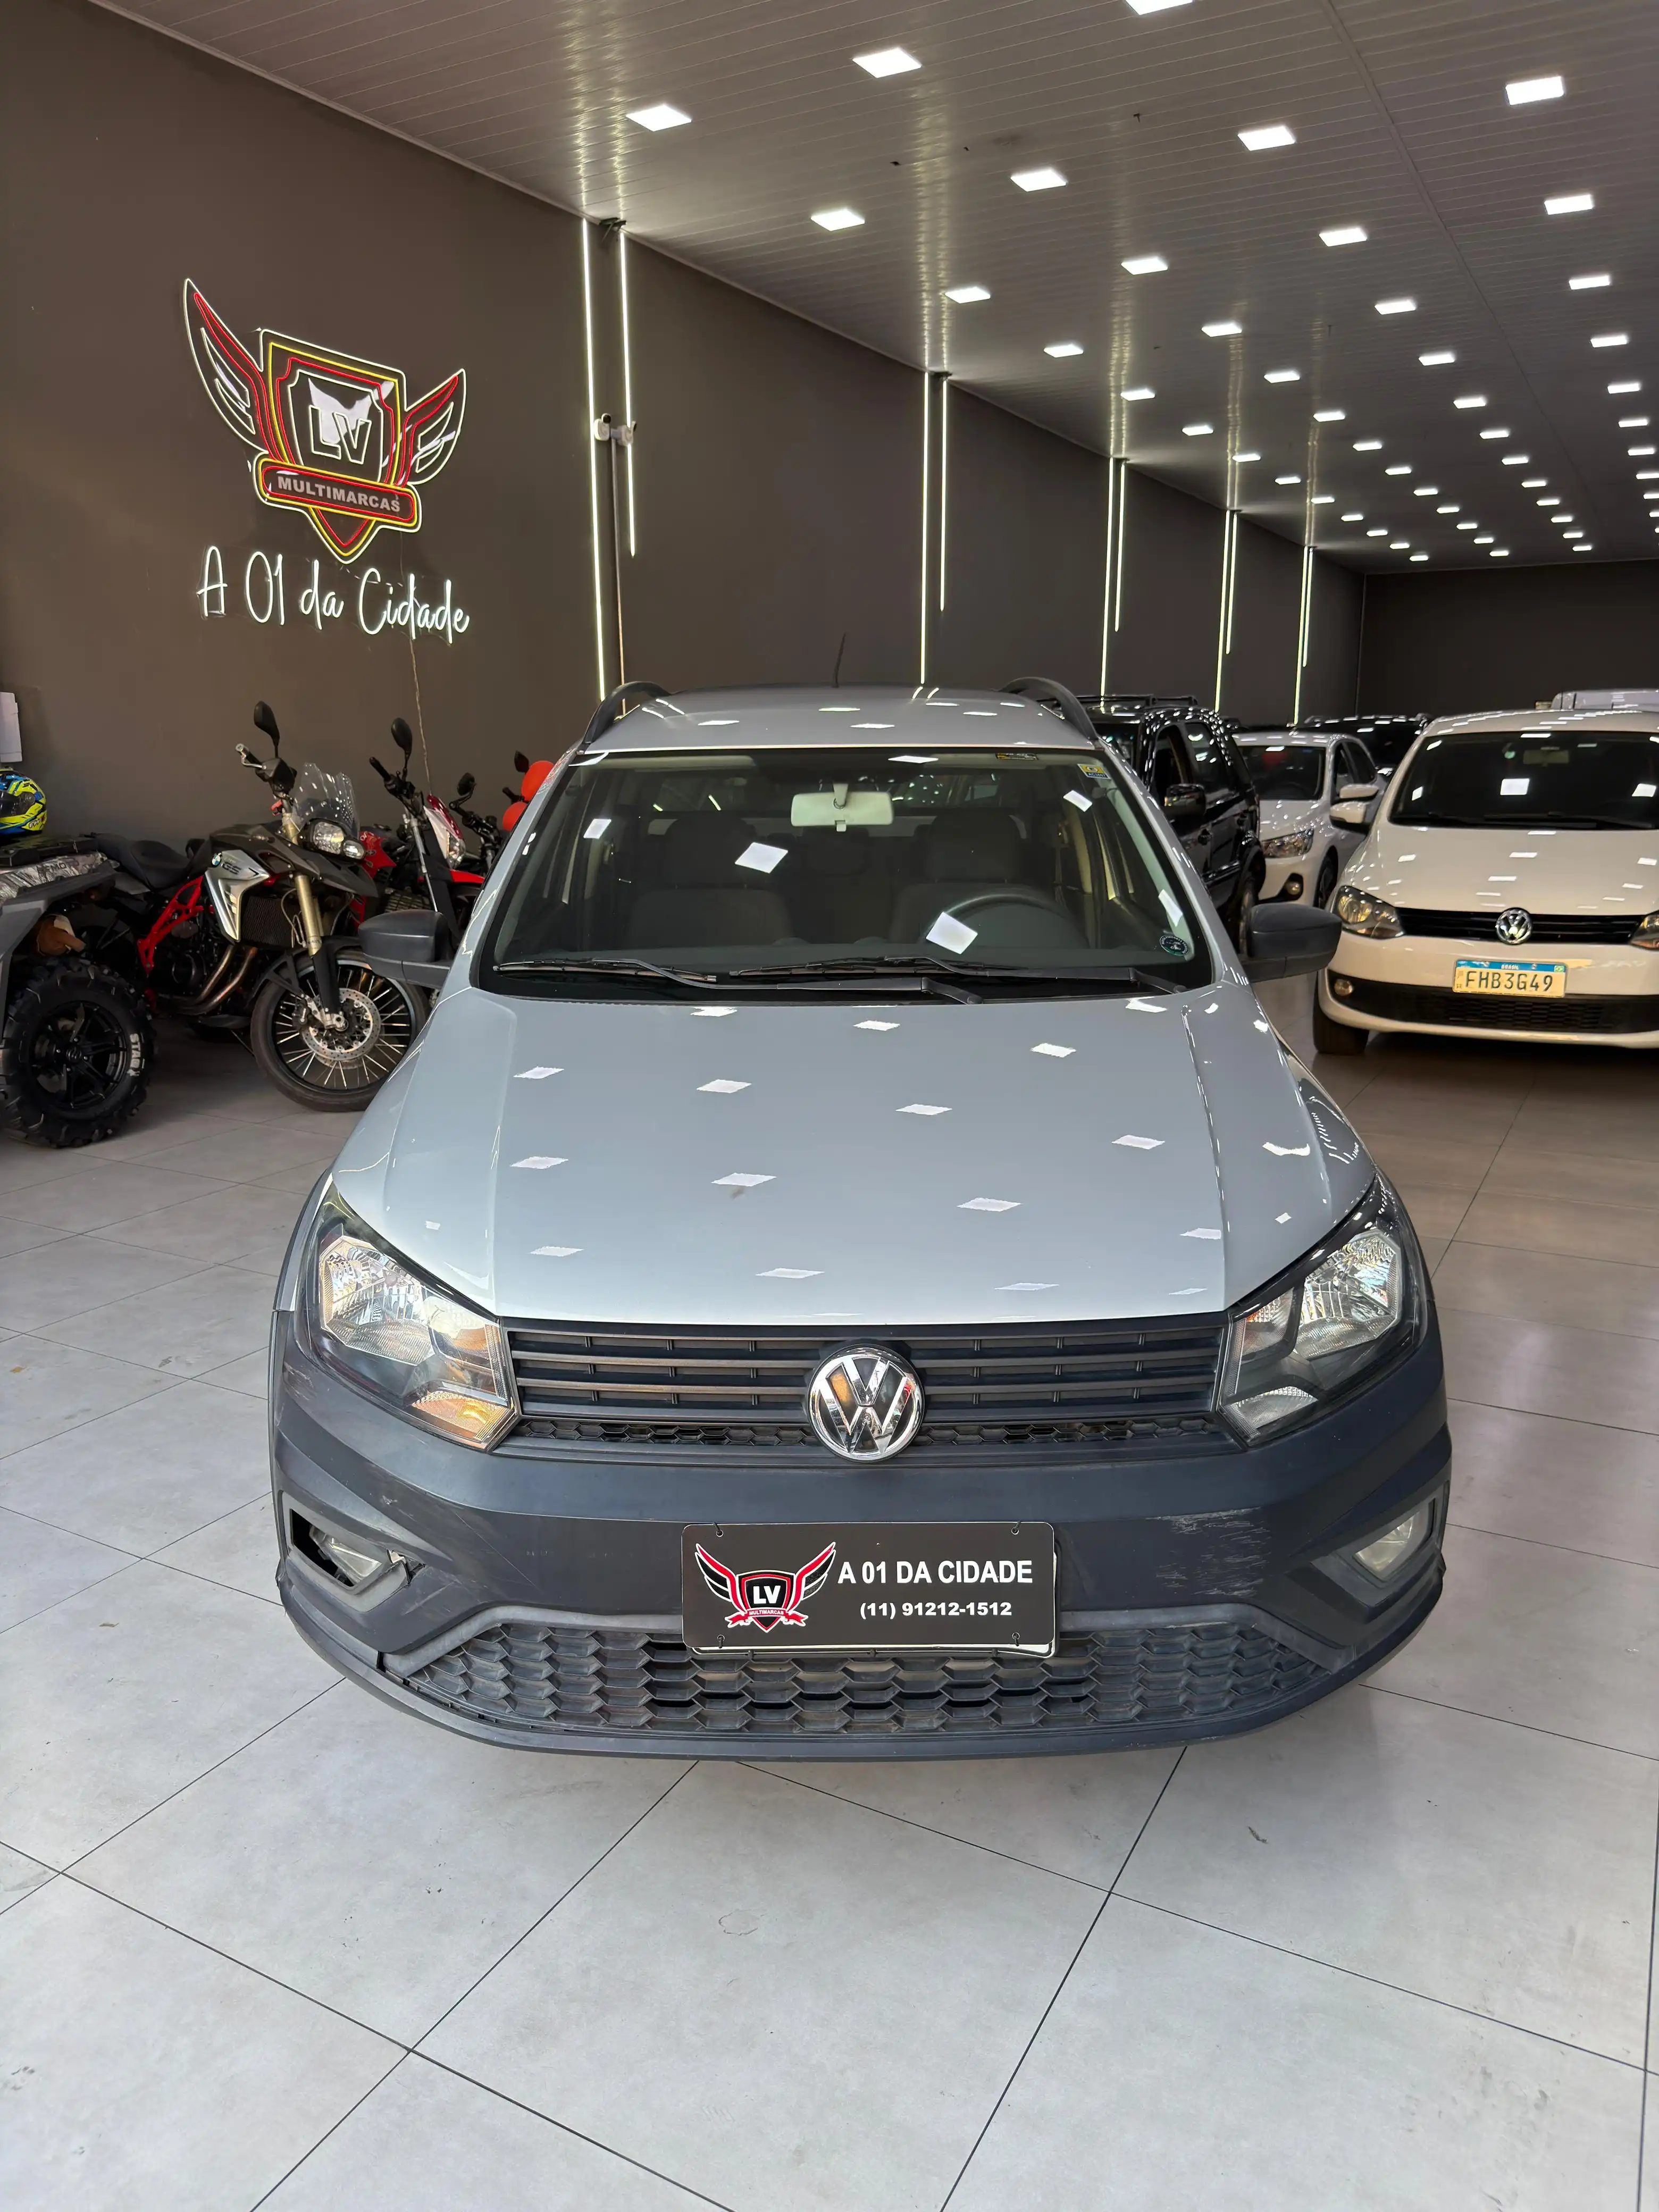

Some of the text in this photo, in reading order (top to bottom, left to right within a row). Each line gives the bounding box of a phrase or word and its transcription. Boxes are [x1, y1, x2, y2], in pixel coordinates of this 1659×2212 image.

[308, 404, 372, 465] LV
[277, 475, 400, 513] MULTIMARCAS
[196, 546, 228, 617] A
[300, 559, 345, 630] da
[358, 567, 470, 644] Cidade
[1465, 971, 1554, 992] FHB3G49
[837, 1560, 1033, 1584] A 01 DA CIDADE
[753, 1585, 781, 1604] LV
[860, 1602, 1012, 1620] (11) 91212-1512
